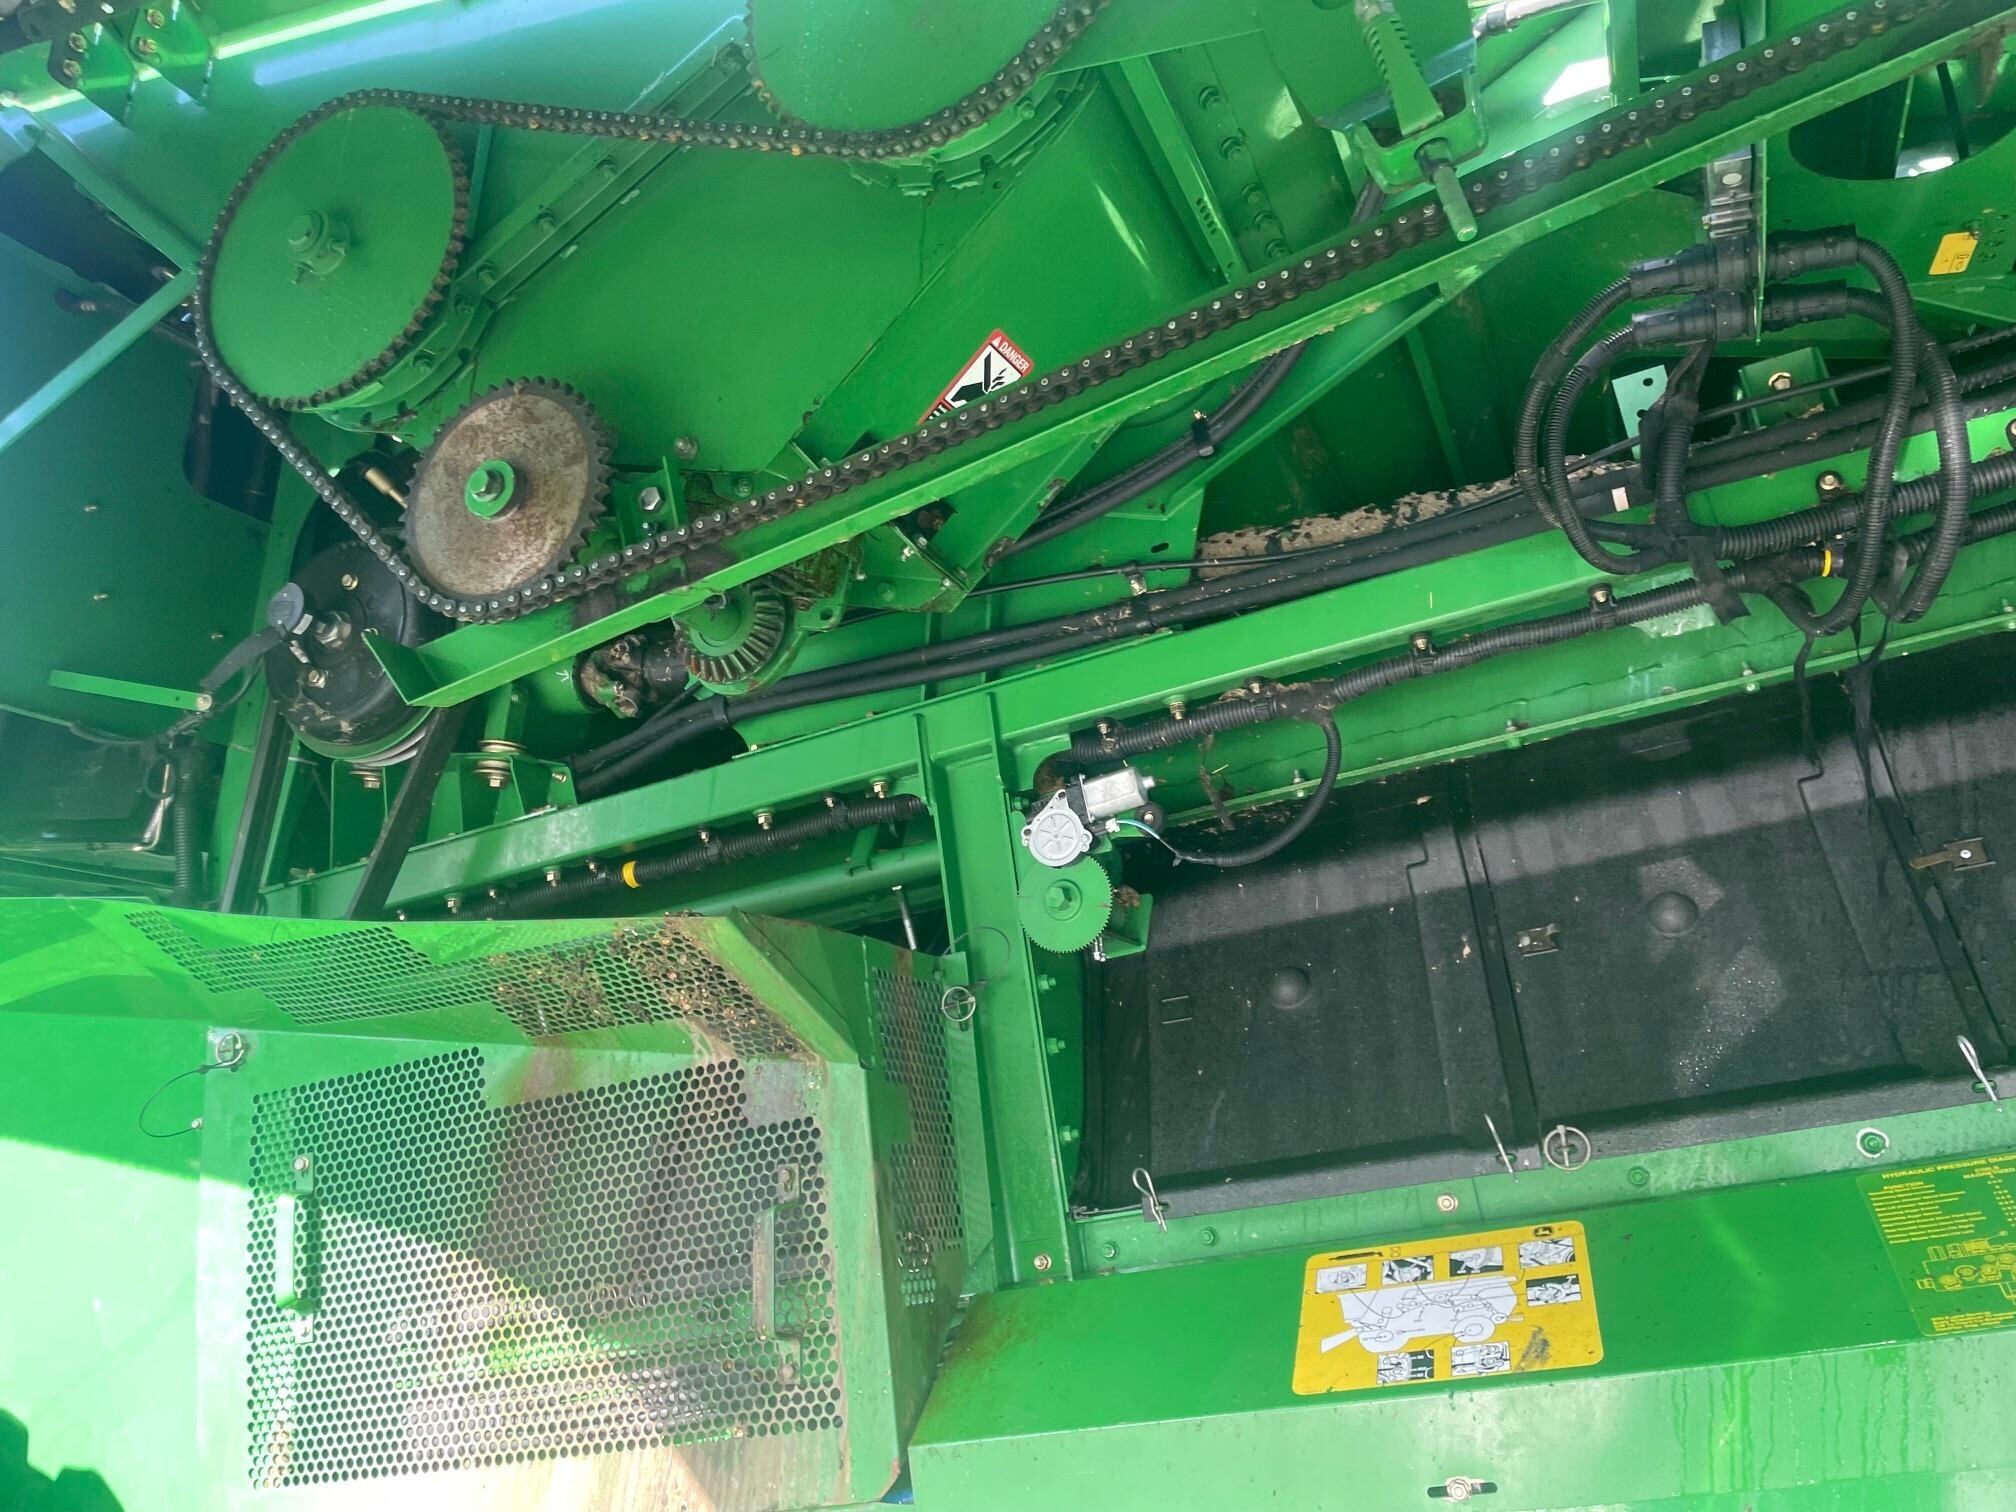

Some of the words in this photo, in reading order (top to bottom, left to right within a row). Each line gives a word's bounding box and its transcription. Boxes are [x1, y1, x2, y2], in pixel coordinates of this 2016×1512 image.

[998, 341, 1030, 373] DANGER
[1882, 1167, 1936, 1179] HYDRAULIC
[1936, 1159, 1987, 1170] PRESSURE
[1883, 1181, 1924, 1190] FUNCTION
